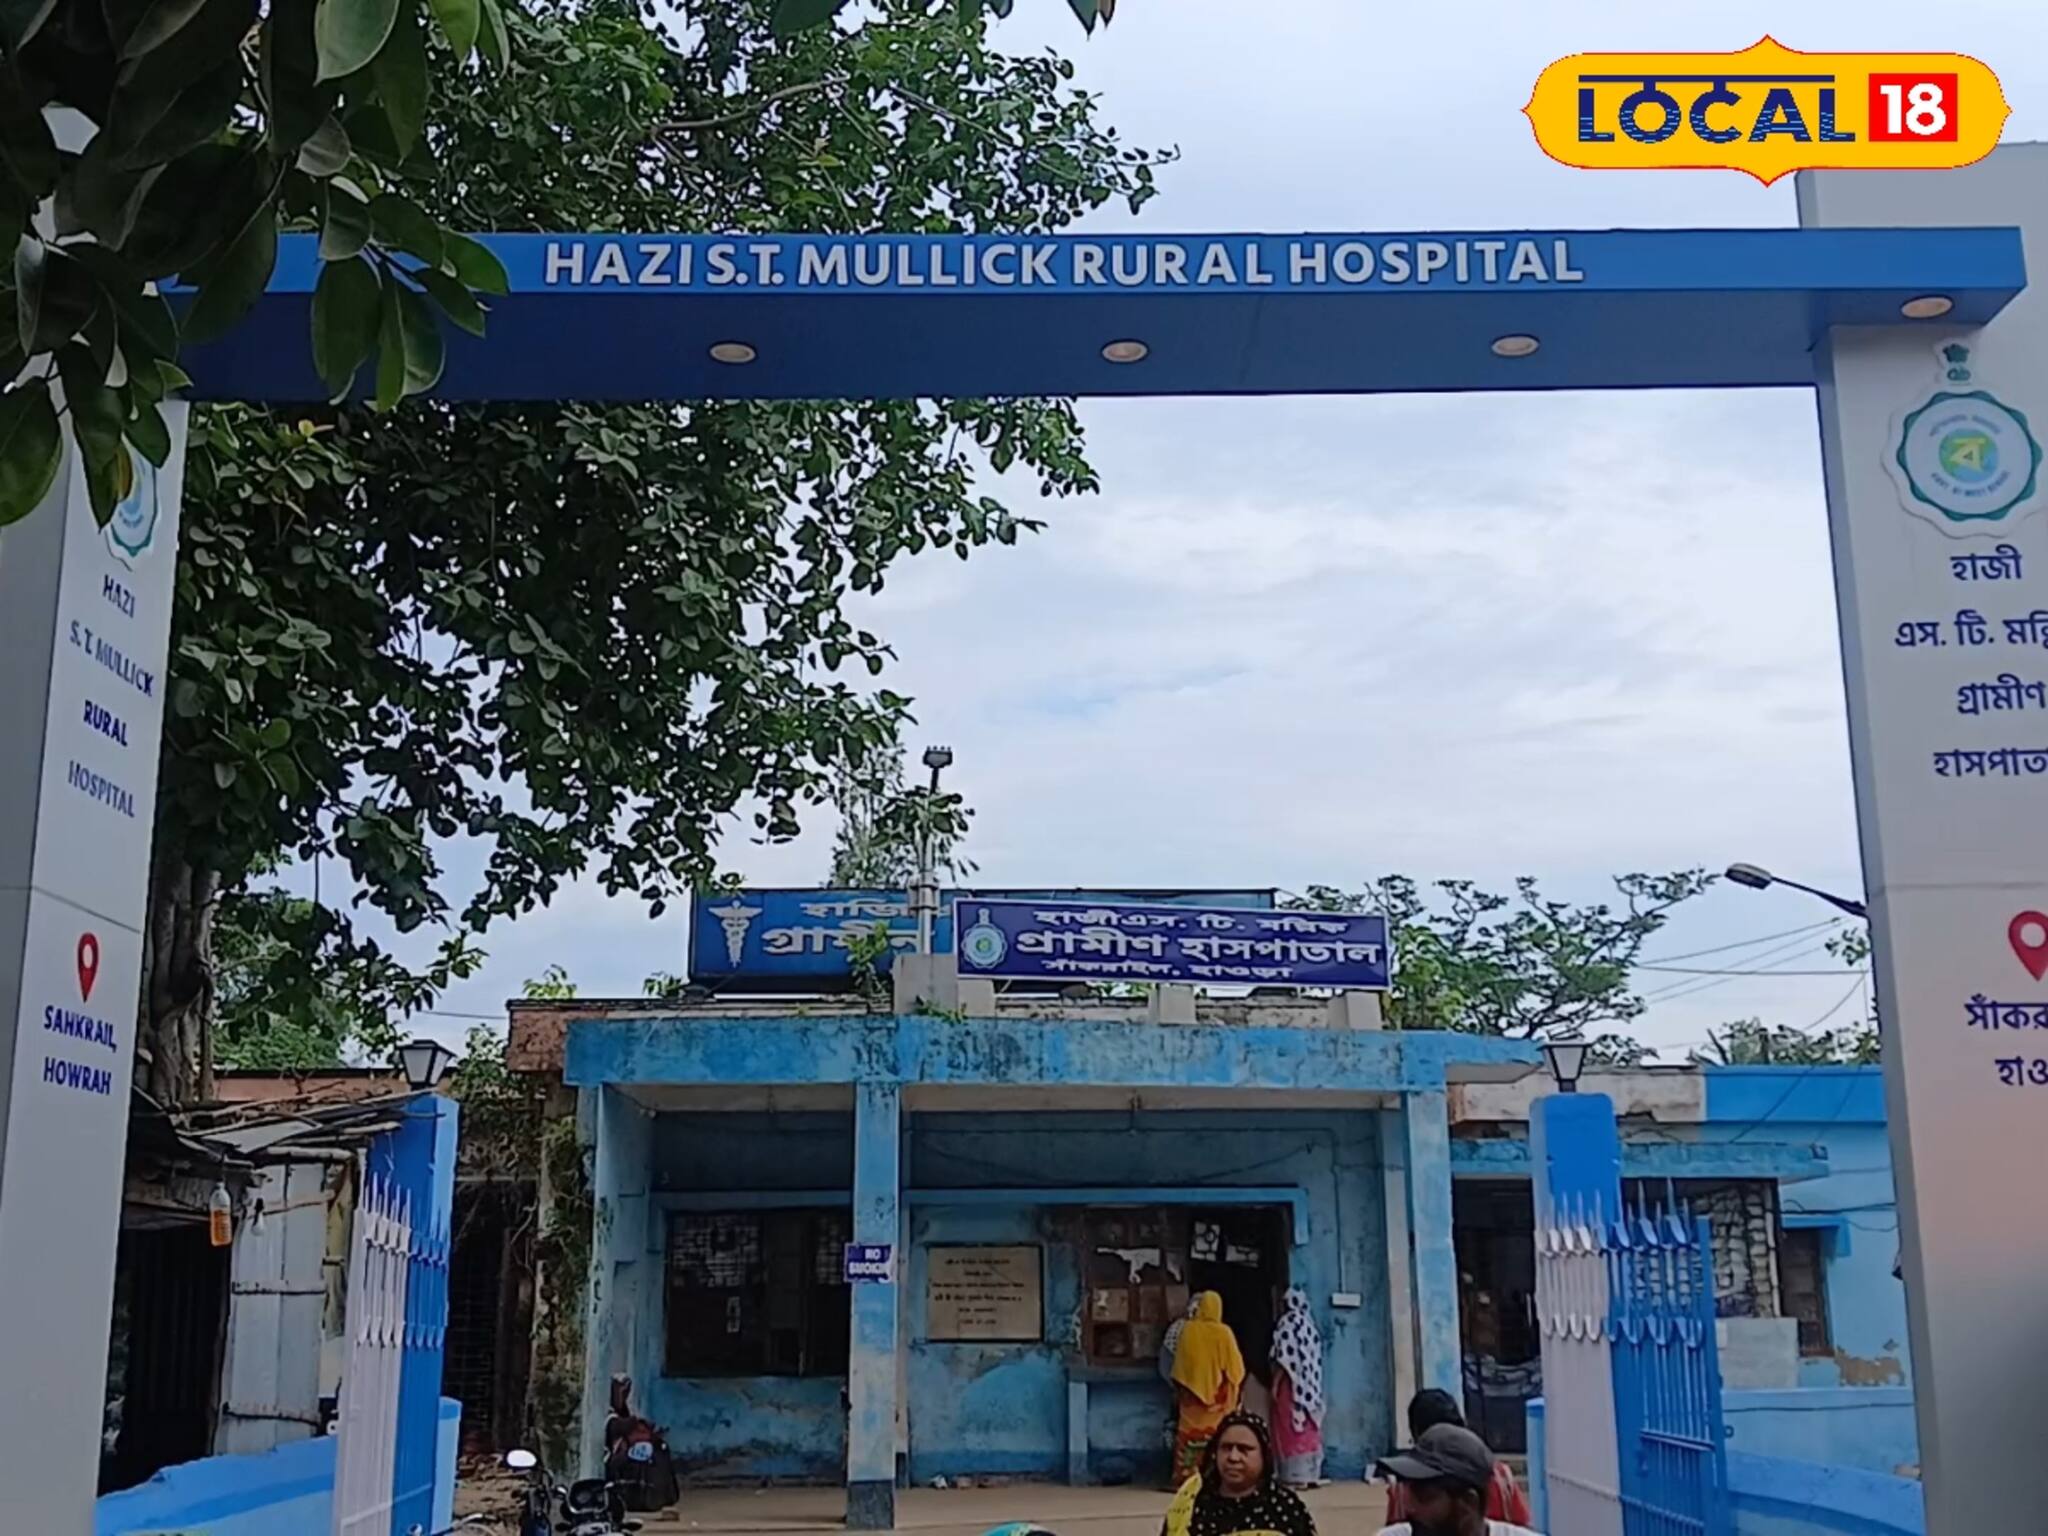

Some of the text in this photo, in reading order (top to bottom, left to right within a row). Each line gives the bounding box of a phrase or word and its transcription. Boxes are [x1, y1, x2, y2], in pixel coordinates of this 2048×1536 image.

[544, 240, 1585, 286] HAZI S.T. MULLICK RURAL HOSPITAL
[1949, 543, 2022, 581] হাজী
[102, 574, 136, 619] HAZI
[1956, 673, 2047, 716] গ্রামীণ
[83, 699, 128, 747] RURAL
[67, 759, 135, 818] HOSPITAL
[1016, 926, 1382, 964] গ্রামীণ হাসপাতাল
[43, 1056, 112, 1096] HOWRAH
